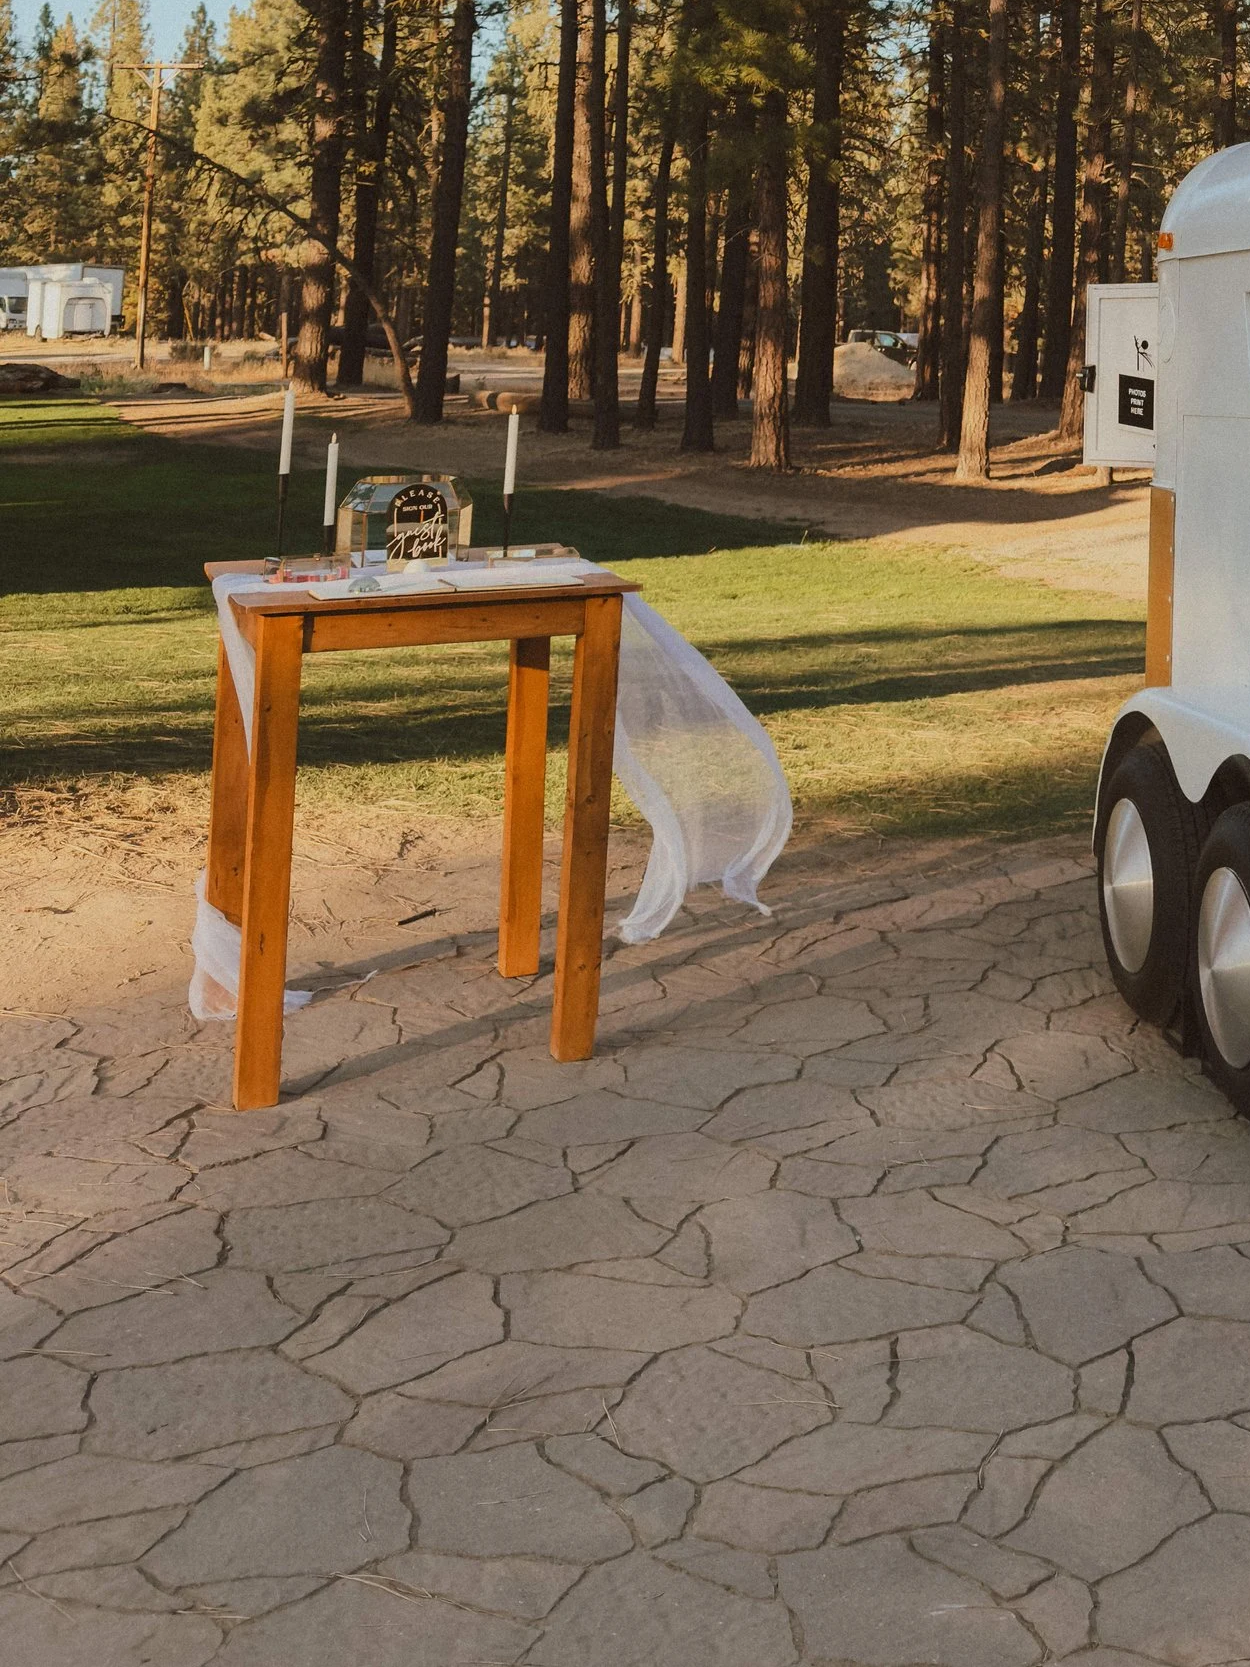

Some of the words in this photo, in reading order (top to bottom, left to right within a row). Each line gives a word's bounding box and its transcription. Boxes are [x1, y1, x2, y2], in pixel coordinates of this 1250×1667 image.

[1129, 388, 1147, 398] PHOTOS
[1131, 398, 1144, 406] PRINT
[1130, 407, 1144, 416] HERE
[394, 489, 441, 507] PLEASE
[386, 511, 445, 564] guest
[407, 525, 447, 558] book
